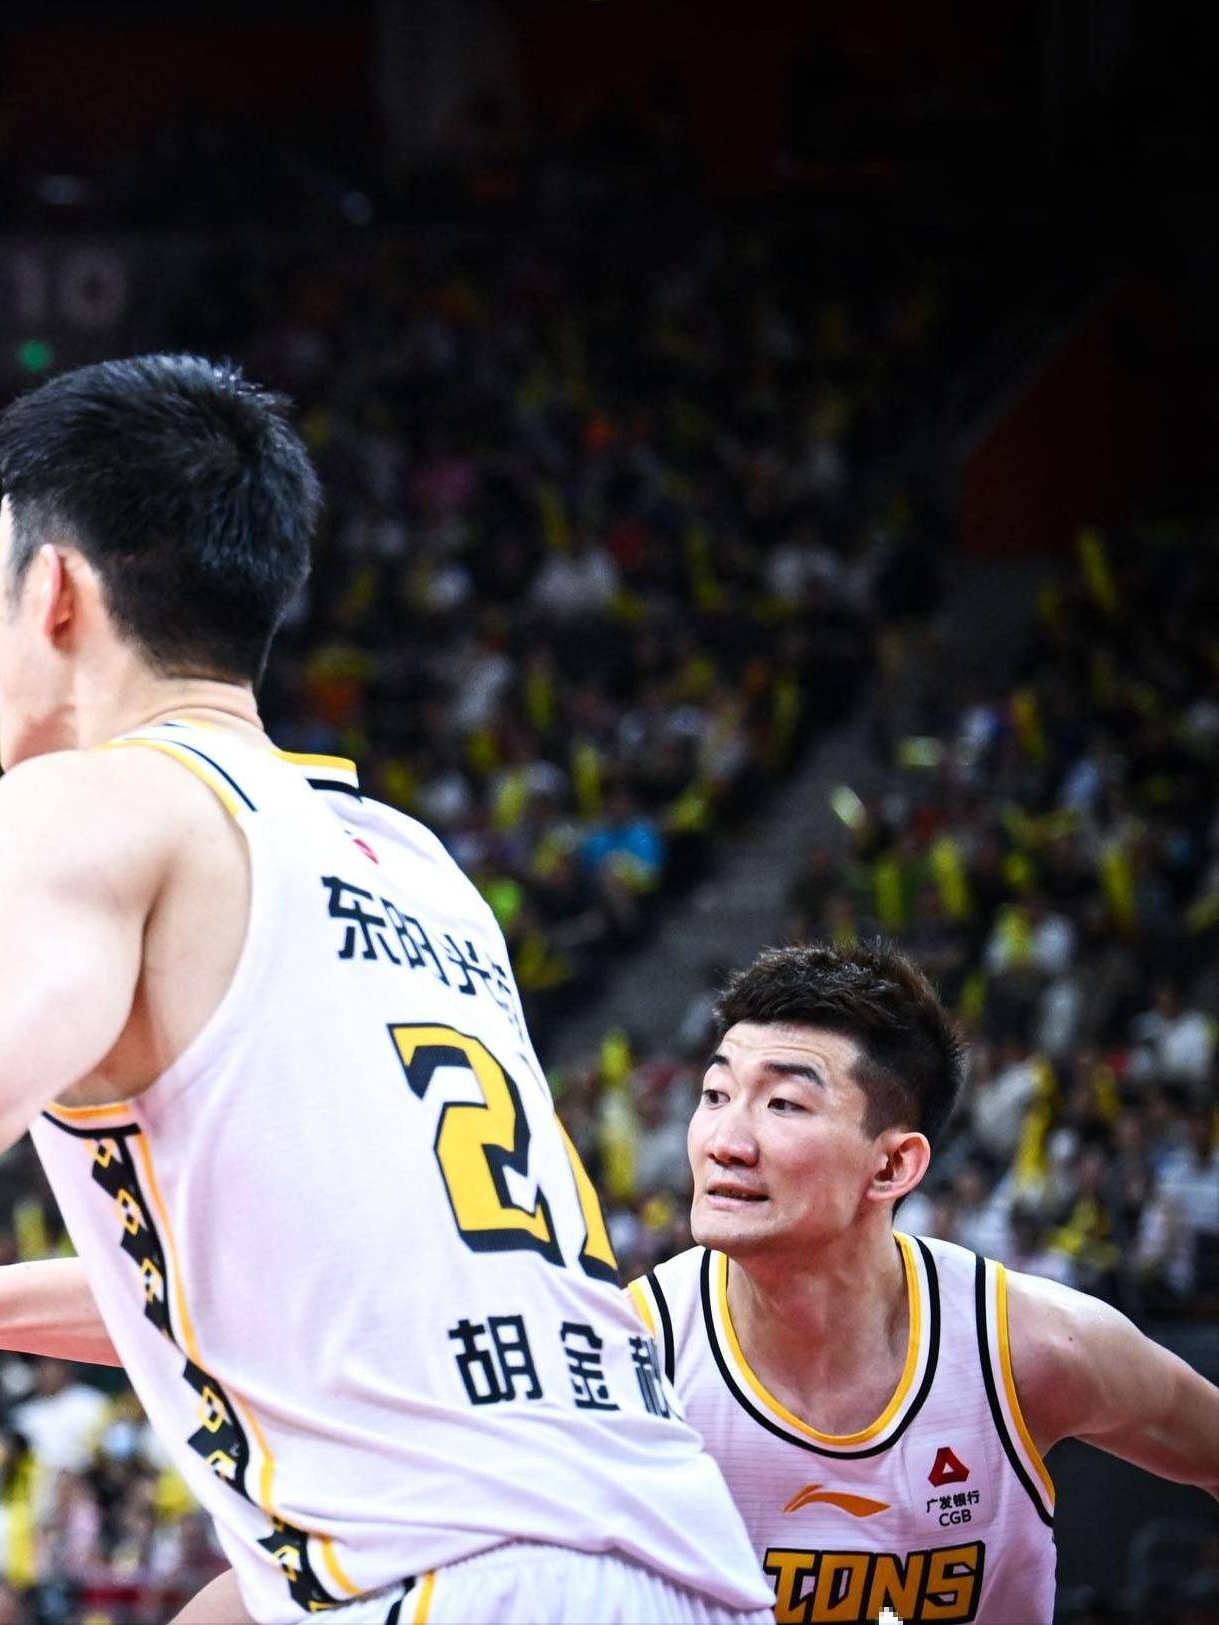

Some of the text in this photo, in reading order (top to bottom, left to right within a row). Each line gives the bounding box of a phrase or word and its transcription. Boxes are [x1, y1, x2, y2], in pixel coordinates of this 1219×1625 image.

[926, 1490, 980, 1513] 广发银行
[938, 1508, 972, 1527] CGB
